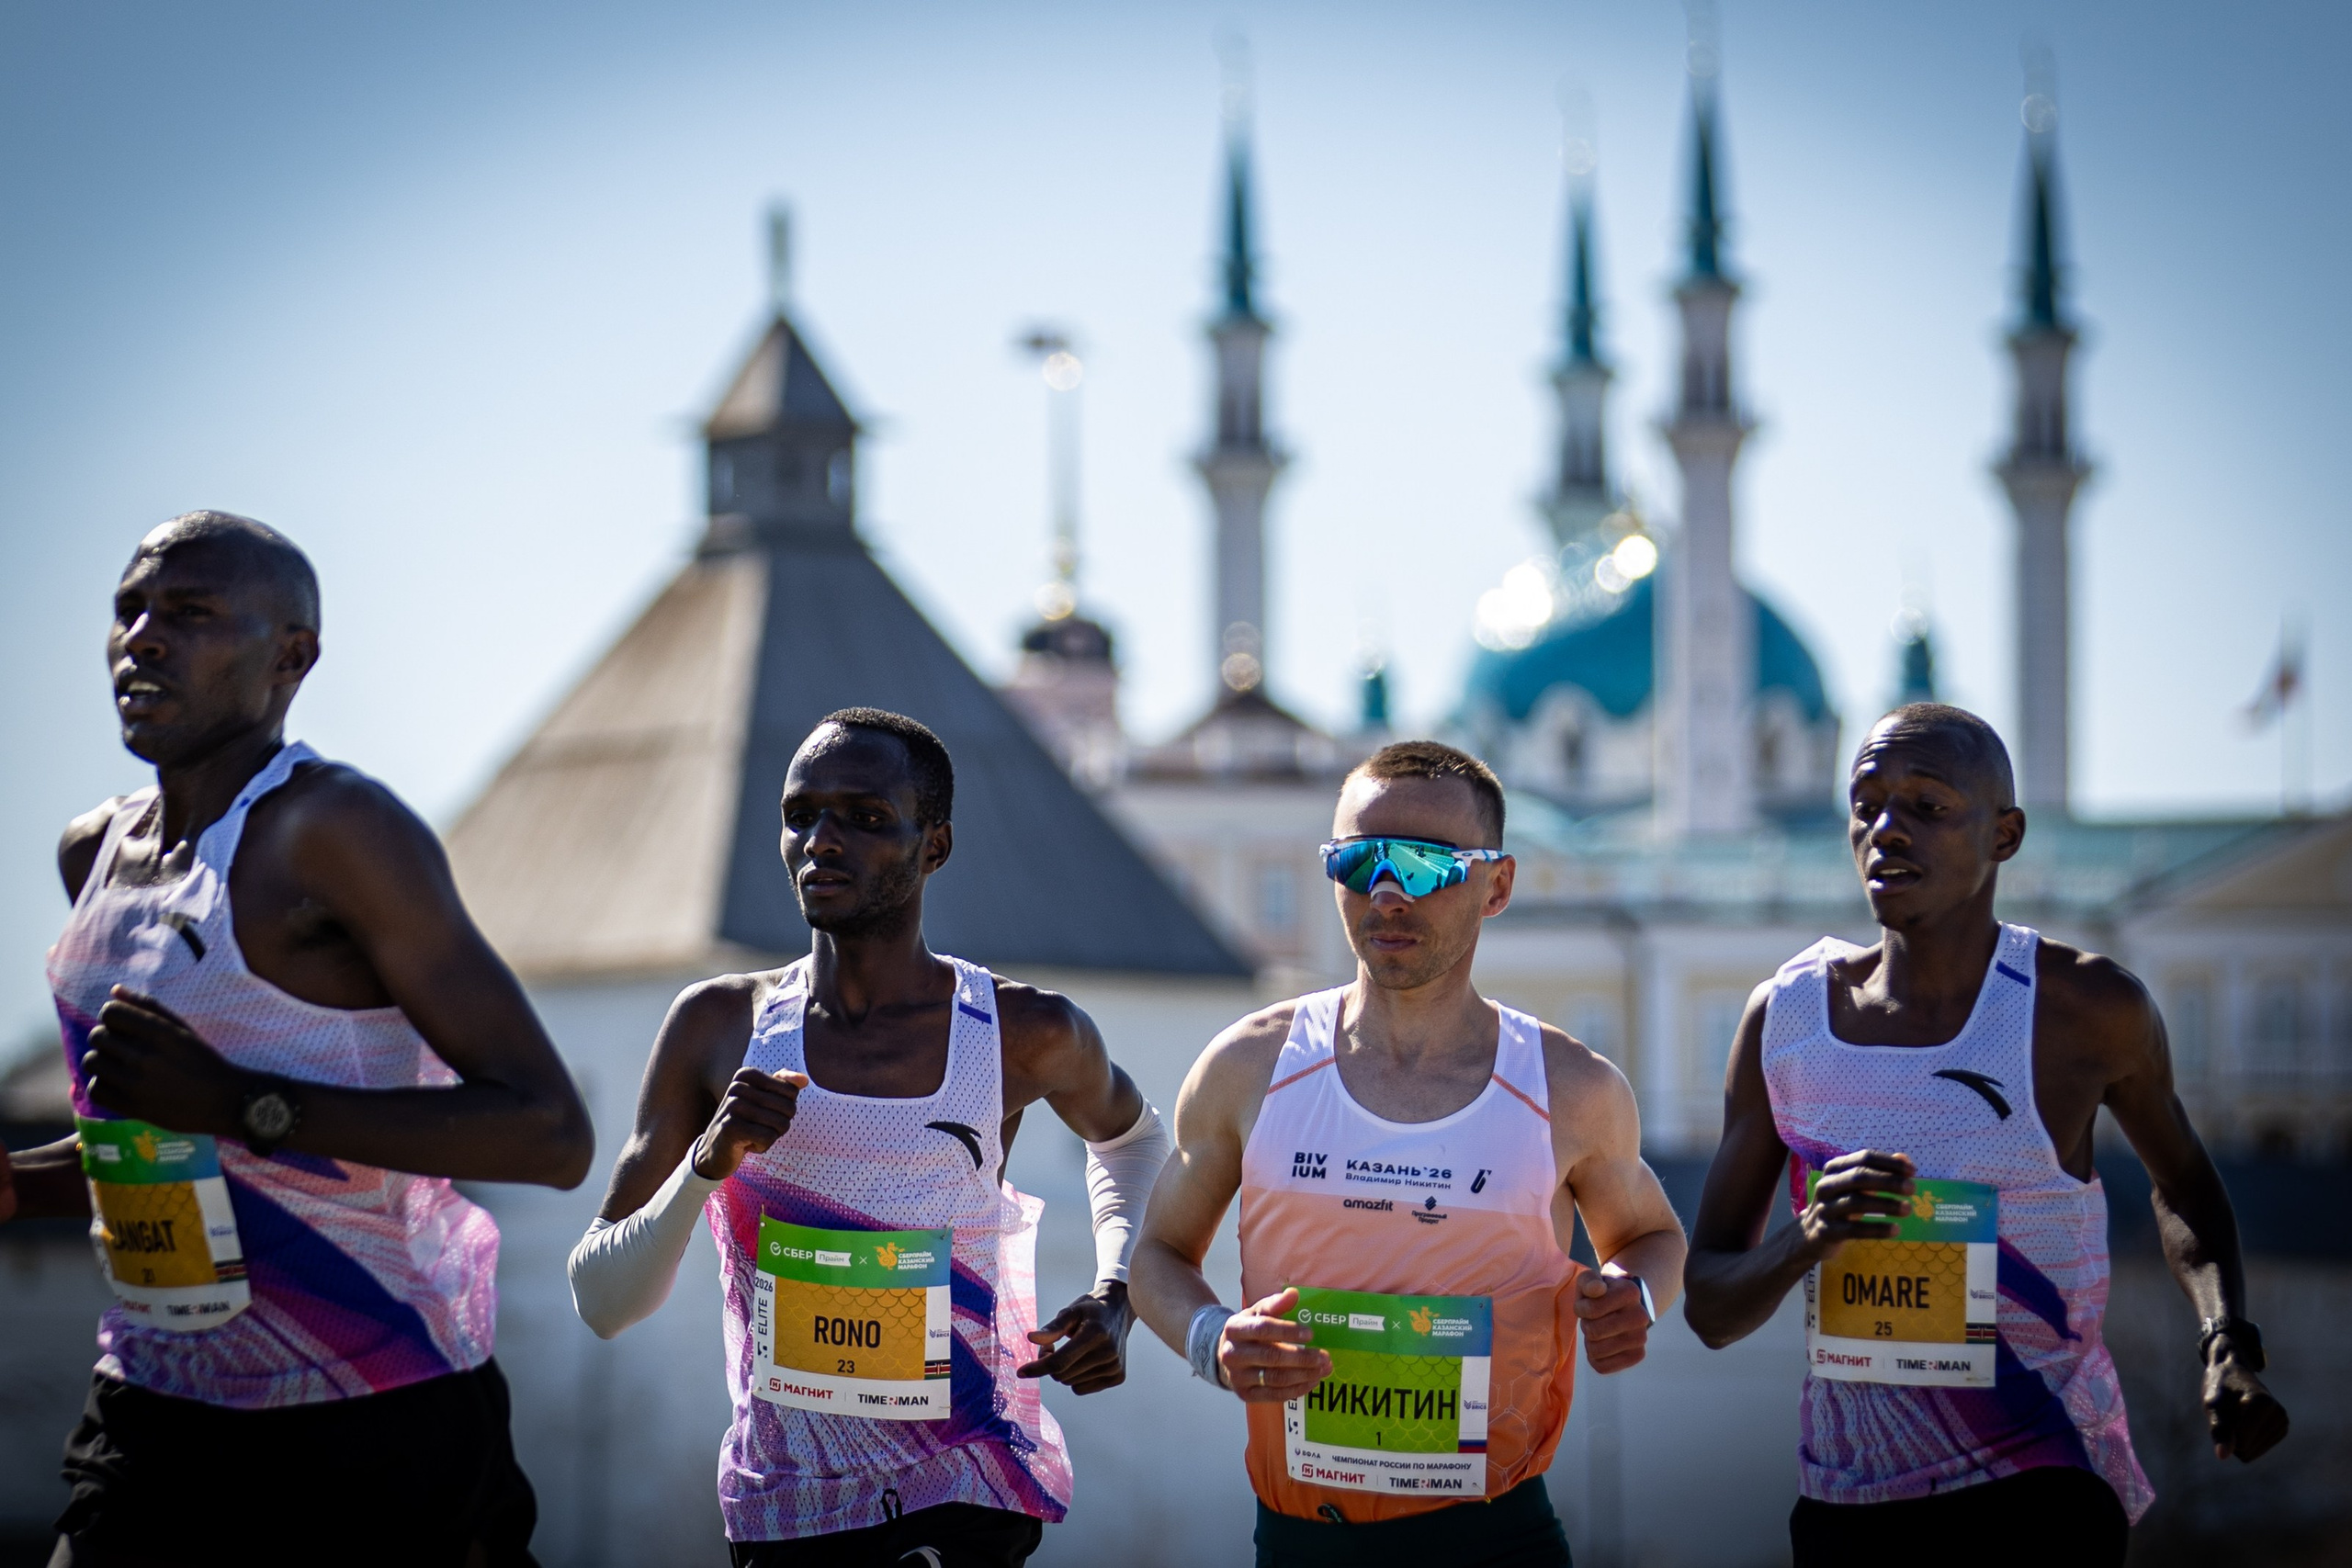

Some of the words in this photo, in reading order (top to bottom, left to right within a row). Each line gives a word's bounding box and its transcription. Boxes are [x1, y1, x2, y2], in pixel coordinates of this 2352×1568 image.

[1294, 1151, 1329, 1166] BIV
[1291, 1165, 1327, 1179] IUM
[1345, 1172, 1402, 1187] Владимир
[1405, 1179, 1452, 1190] Никитин
[1343, 1198, 1394, 1212] amazfit
[783, 1247, 813, 1260] СБЕР
[819, 1253, 844, 1263] Прайм
[754, 1277, 774, 1292] 2026
[1843, 1272, 1930, 1309] OMARE
[757, 1297, 768, 1336] ELITE
[1314, 1313, 1347, 1325] СБЕР
[1352, 1318, 1378, 1327] Прайм
[814, 1315, 881, 1348] RONO
[1874, 1321, 1893, 1336] 25
[837, 1359, 855, 1373] 23
[1826, 1352, 1872, 1367] МАГНИТ
[784, 1382, 833, 1400] МАГНИТ
[1307, 1381, 1456, 1421] НИКИТИН
[1375, 1431, 1382, 1446] 1
[1332, 1455, 1378, 1467] ЧЕМПИОНАТ
[1379, 1461, 1411, 1470] РОССИИ
[1317, 1468, 1365, 1484] МАГНИТ
